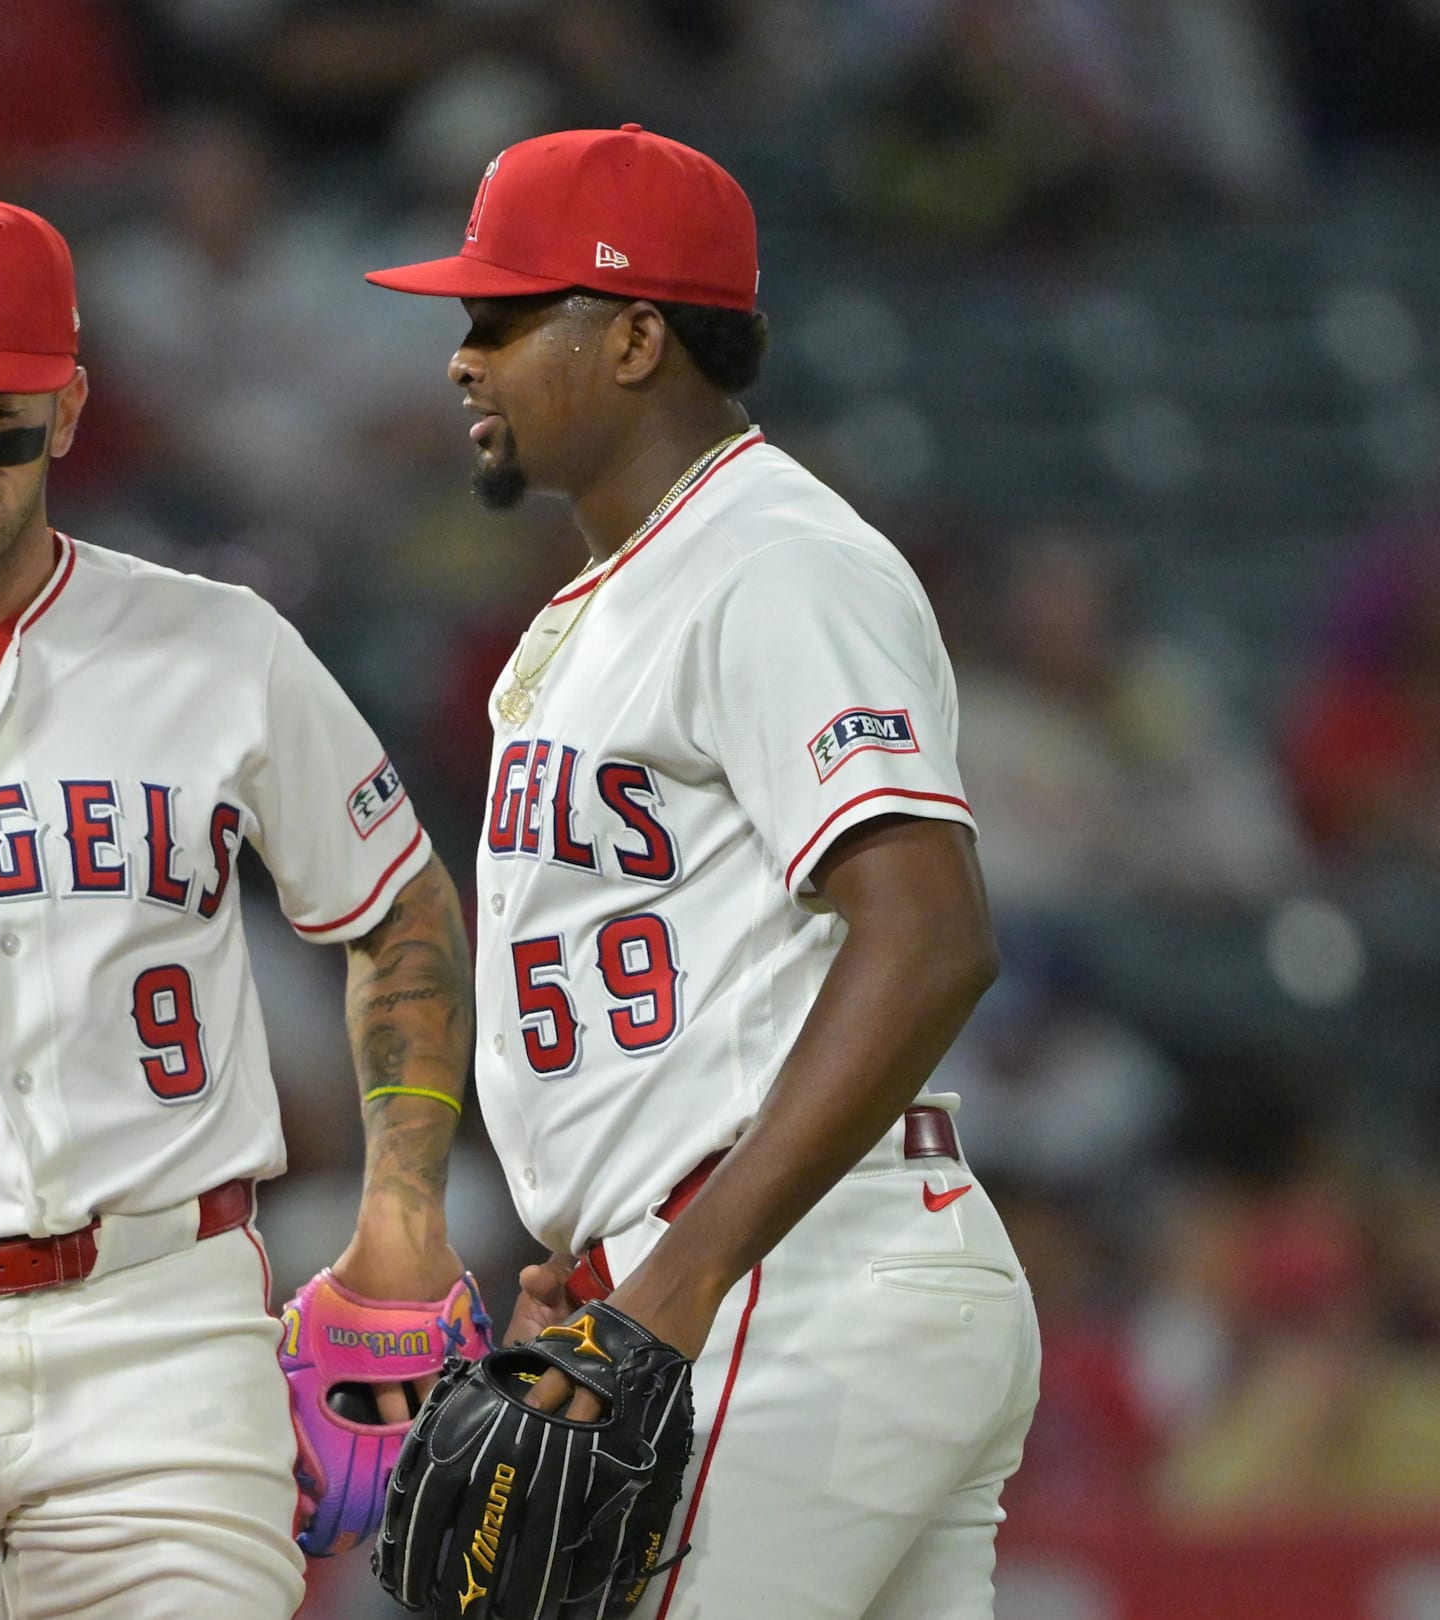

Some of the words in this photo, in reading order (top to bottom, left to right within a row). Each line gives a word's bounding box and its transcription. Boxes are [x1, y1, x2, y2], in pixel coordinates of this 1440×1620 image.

[841, 715, 899, 739] FBM
[486, 738, 684, 887] GELS
[130, 962, 214, 1102] 9
[510, 911, 688, 1082] 59
[327, 1325, 432, 1360] Wilson
